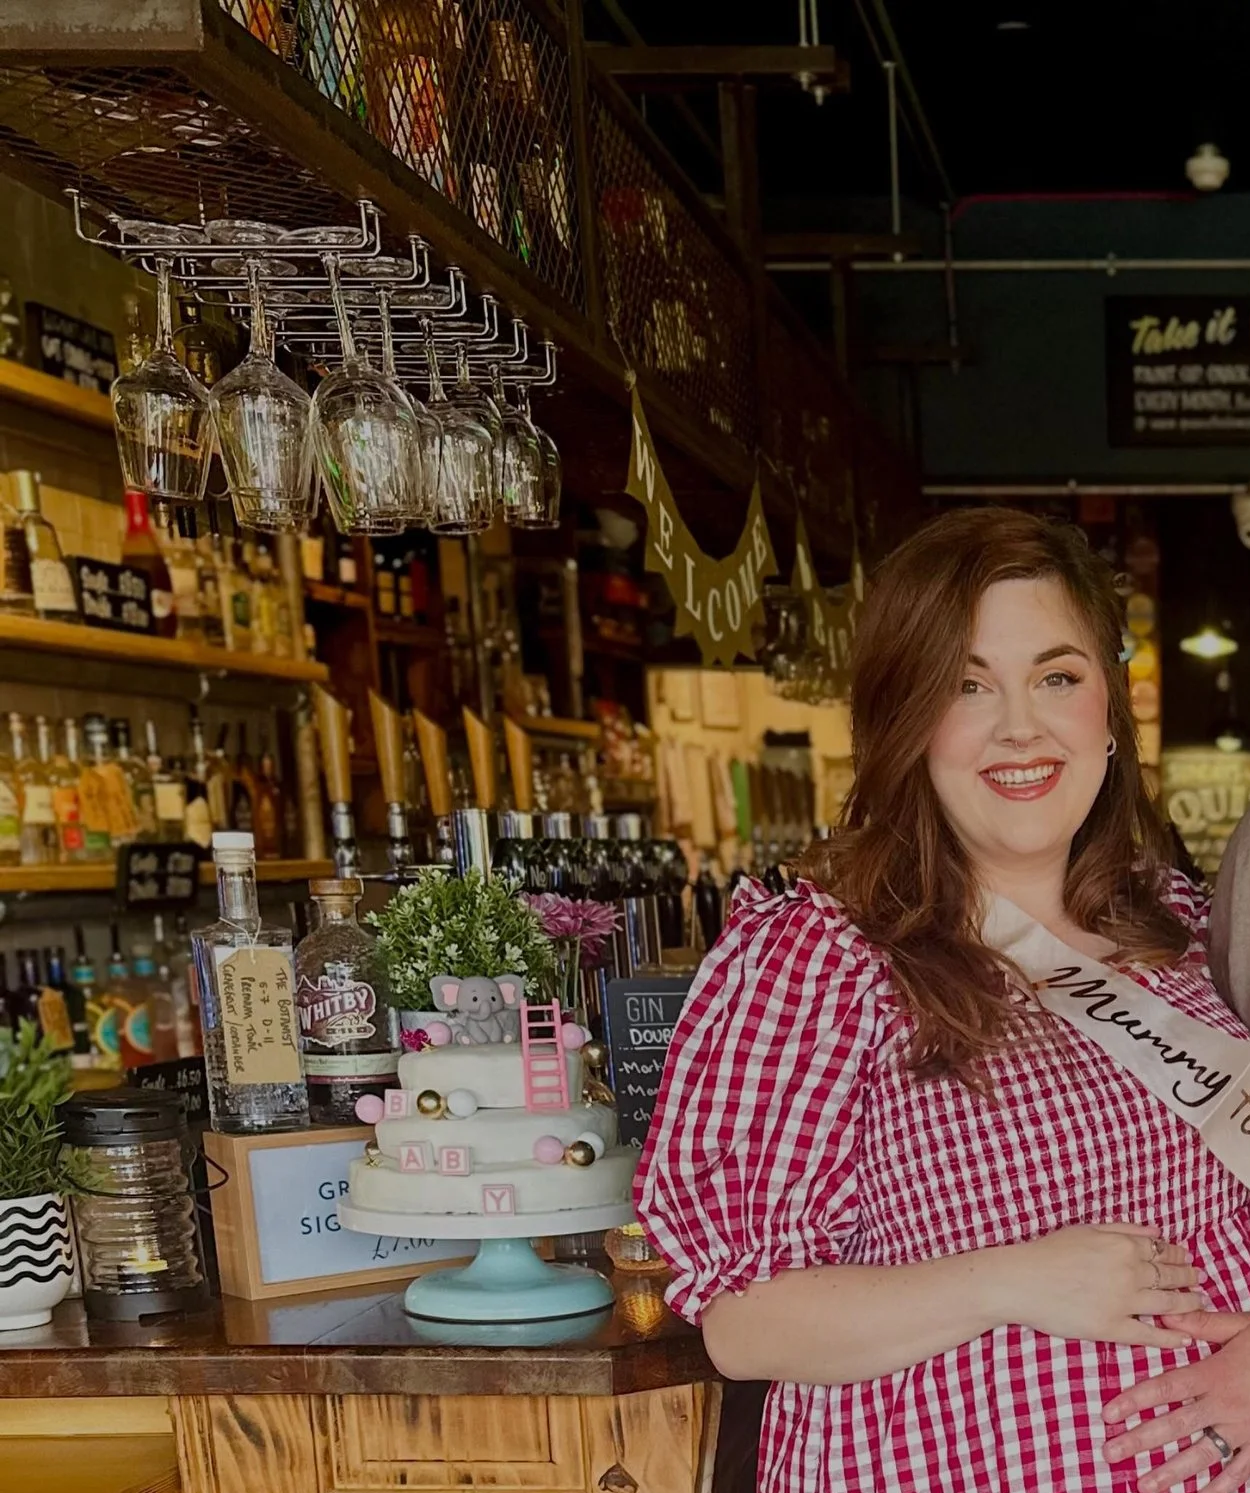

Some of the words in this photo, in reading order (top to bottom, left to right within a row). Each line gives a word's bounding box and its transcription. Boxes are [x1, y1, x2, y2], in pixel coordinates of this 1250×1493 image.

[1129, 314, 1201, 356] Take
[1204, 305, 1238, 346] it
[633, 413, 767, 642] WELCOME
[240, 976, 253, 1020] PREMIUM
[274, 967, 288, 991] THE
[277, 998, 297, 1055] BOTANIST
[299, 987, 368, 1031] WHITBY
[625, 996, 664, 1023] GIN
[245, 1023, 264, 1053] TONIC
[1033, 966, 1232, 1107] Mummy
[404, 1148, 421, 1167] A
[446, 1151, 461, 1169] B
[488, 1190, 507, 1208] Y
